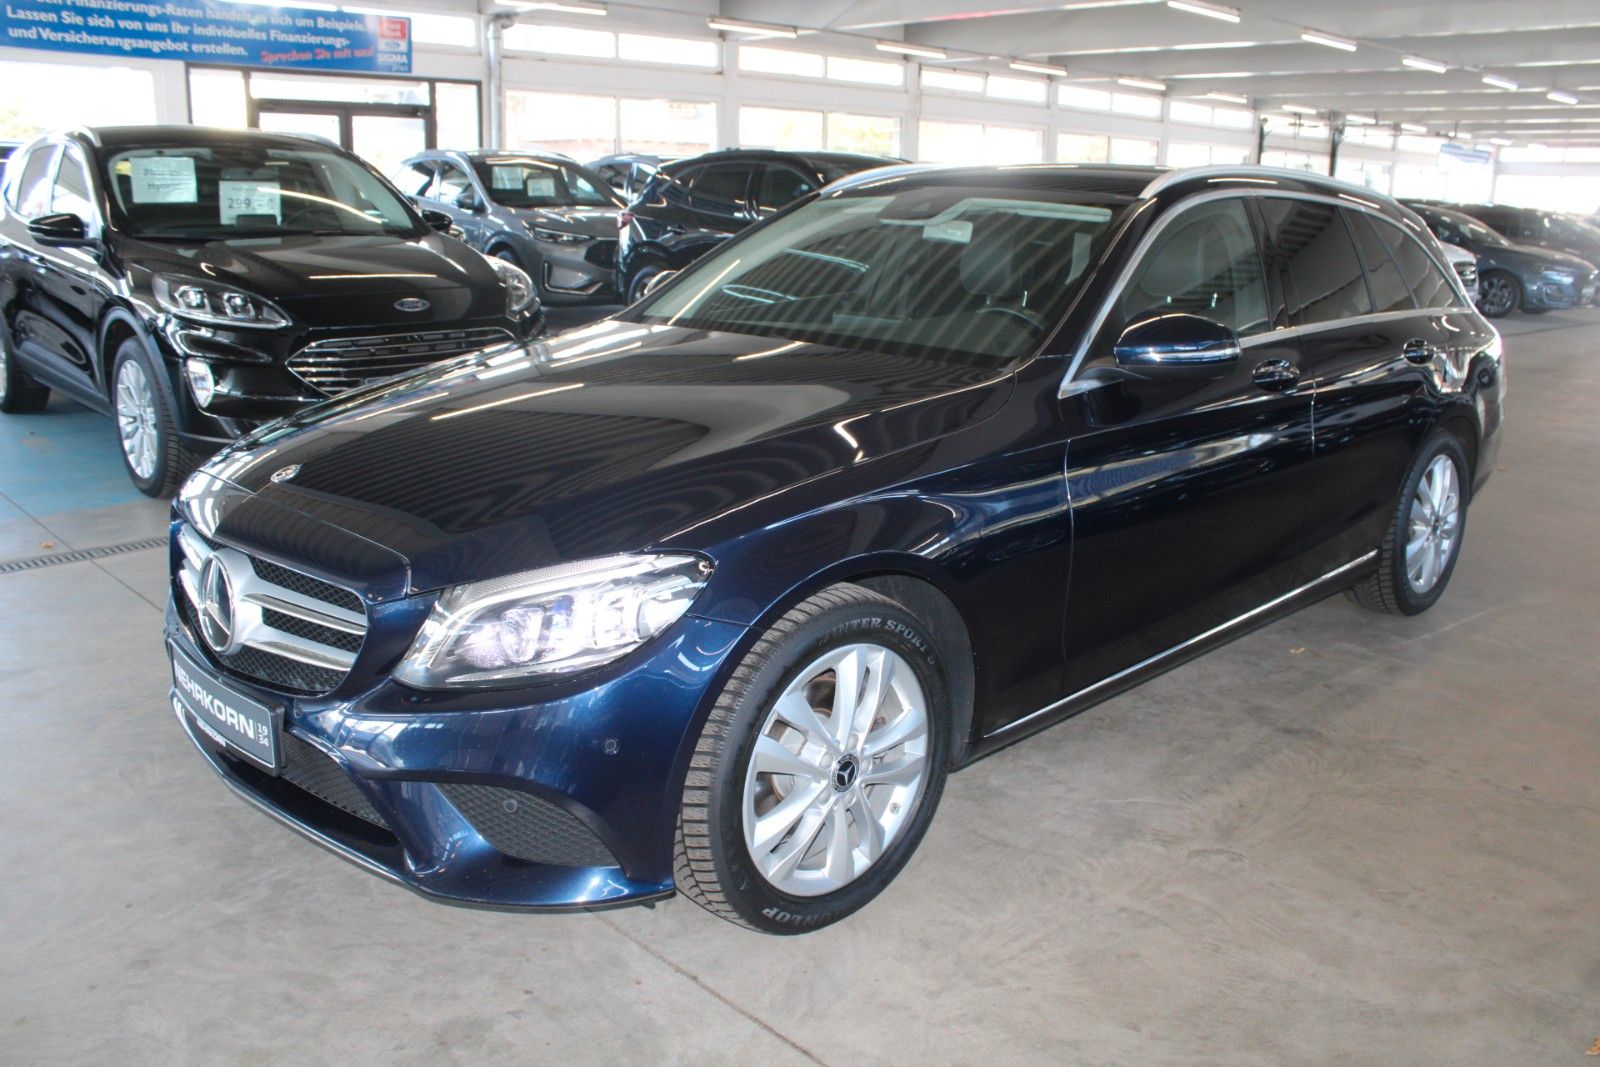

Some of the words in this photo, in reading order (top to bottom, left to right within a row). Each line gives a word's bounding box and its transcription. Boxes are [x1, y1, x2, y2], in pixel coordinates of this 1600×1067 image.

[6, 5, 58, 23] Lassen
[60, 10, 84, 25] Sie
[87, 14, 115, 28] sich
[117, 18, 143, 31] von
[145, 22, 168, 33] uns
[171, 21, 191, 34] Ihr
[193, 23, 267, 41] individuelles
[270, 29, 351, 49] Finanzierungs-
[271, 14, 292, 26] sich
[295, 18, 314, 28] um
[8, 27, 37, 39] und
[37, 27, 190, 53] Versicherungsangebot
[191, 41, 248, 56] erstellen.
[261, 49, 312, 65] Sprechen
[315, 48, 330, 59] Sie
[334, 48, 352, 59] mit
[885, 619, 928, 653] SPORT
